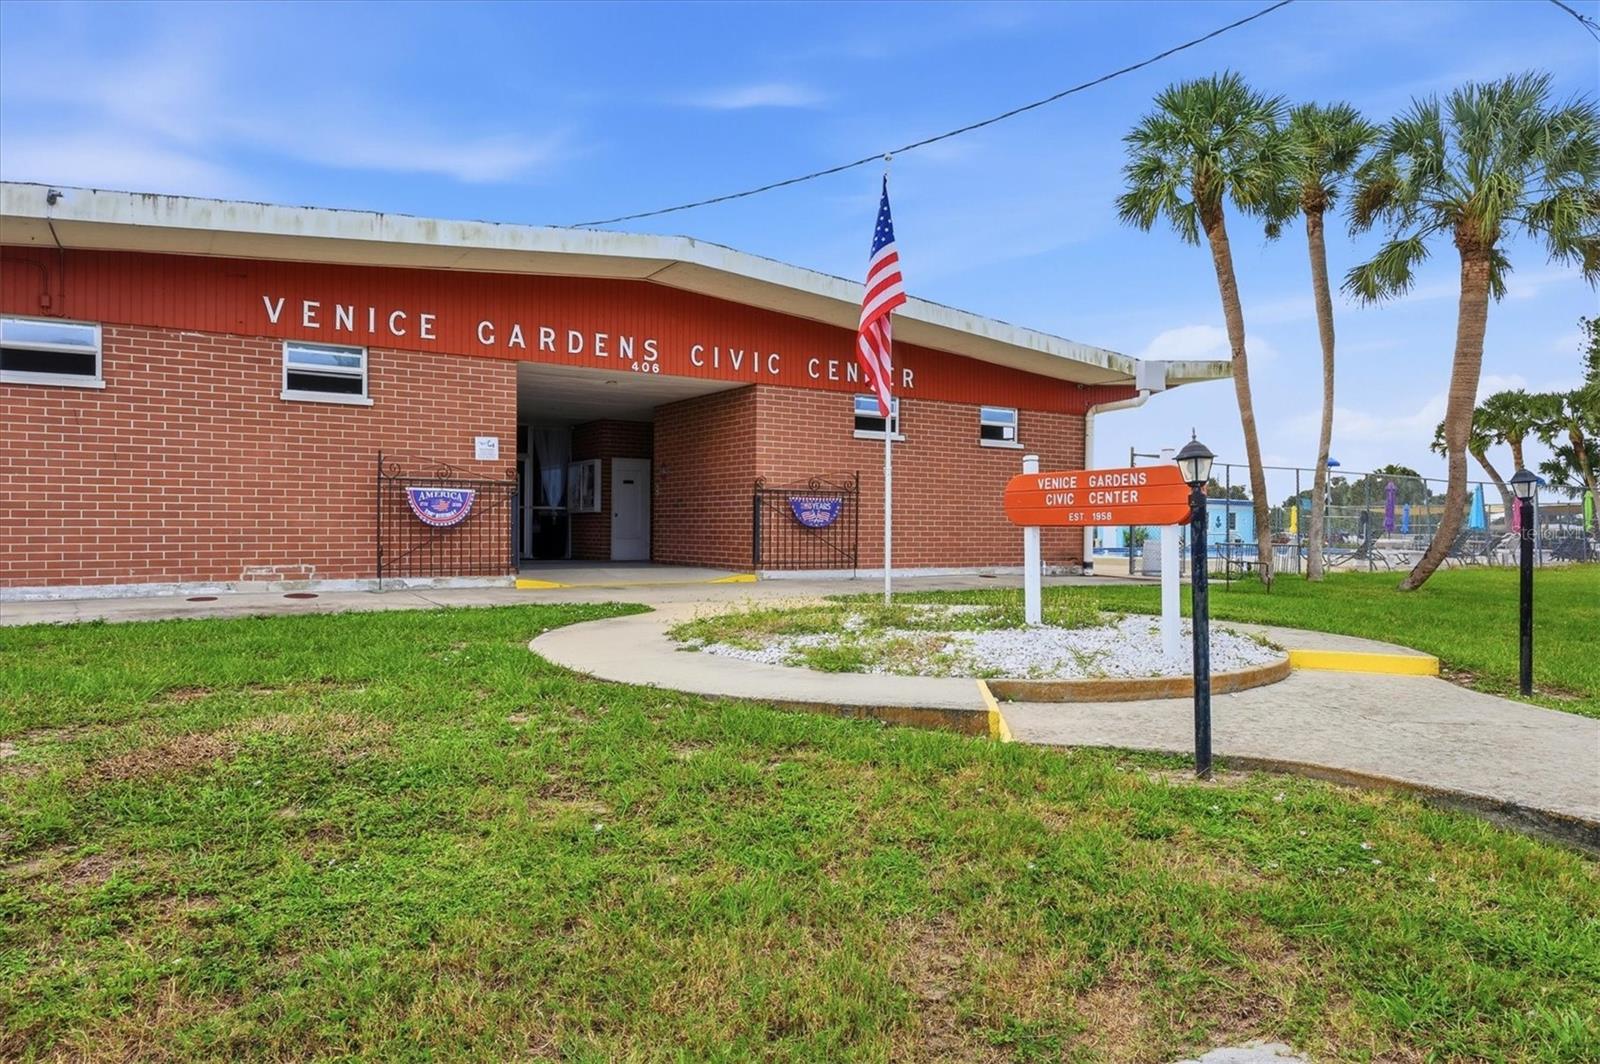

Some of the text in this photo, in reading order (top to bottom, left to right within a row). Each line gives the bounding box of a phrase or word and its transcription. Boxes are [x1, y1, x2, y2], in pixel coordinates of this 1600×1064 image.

[263, 295, 914, 389] VENICE GARDENS CIVIC CENR
[631, 361, 660, 374] 406
[1037, 472, 1147, 490] VENICE GARDENS
[418, 491, 463, 502] AMERICA
[1045, 490, 1139, 506] CIVIC CENTER
[1092, 511, 1113, 521] 1958
